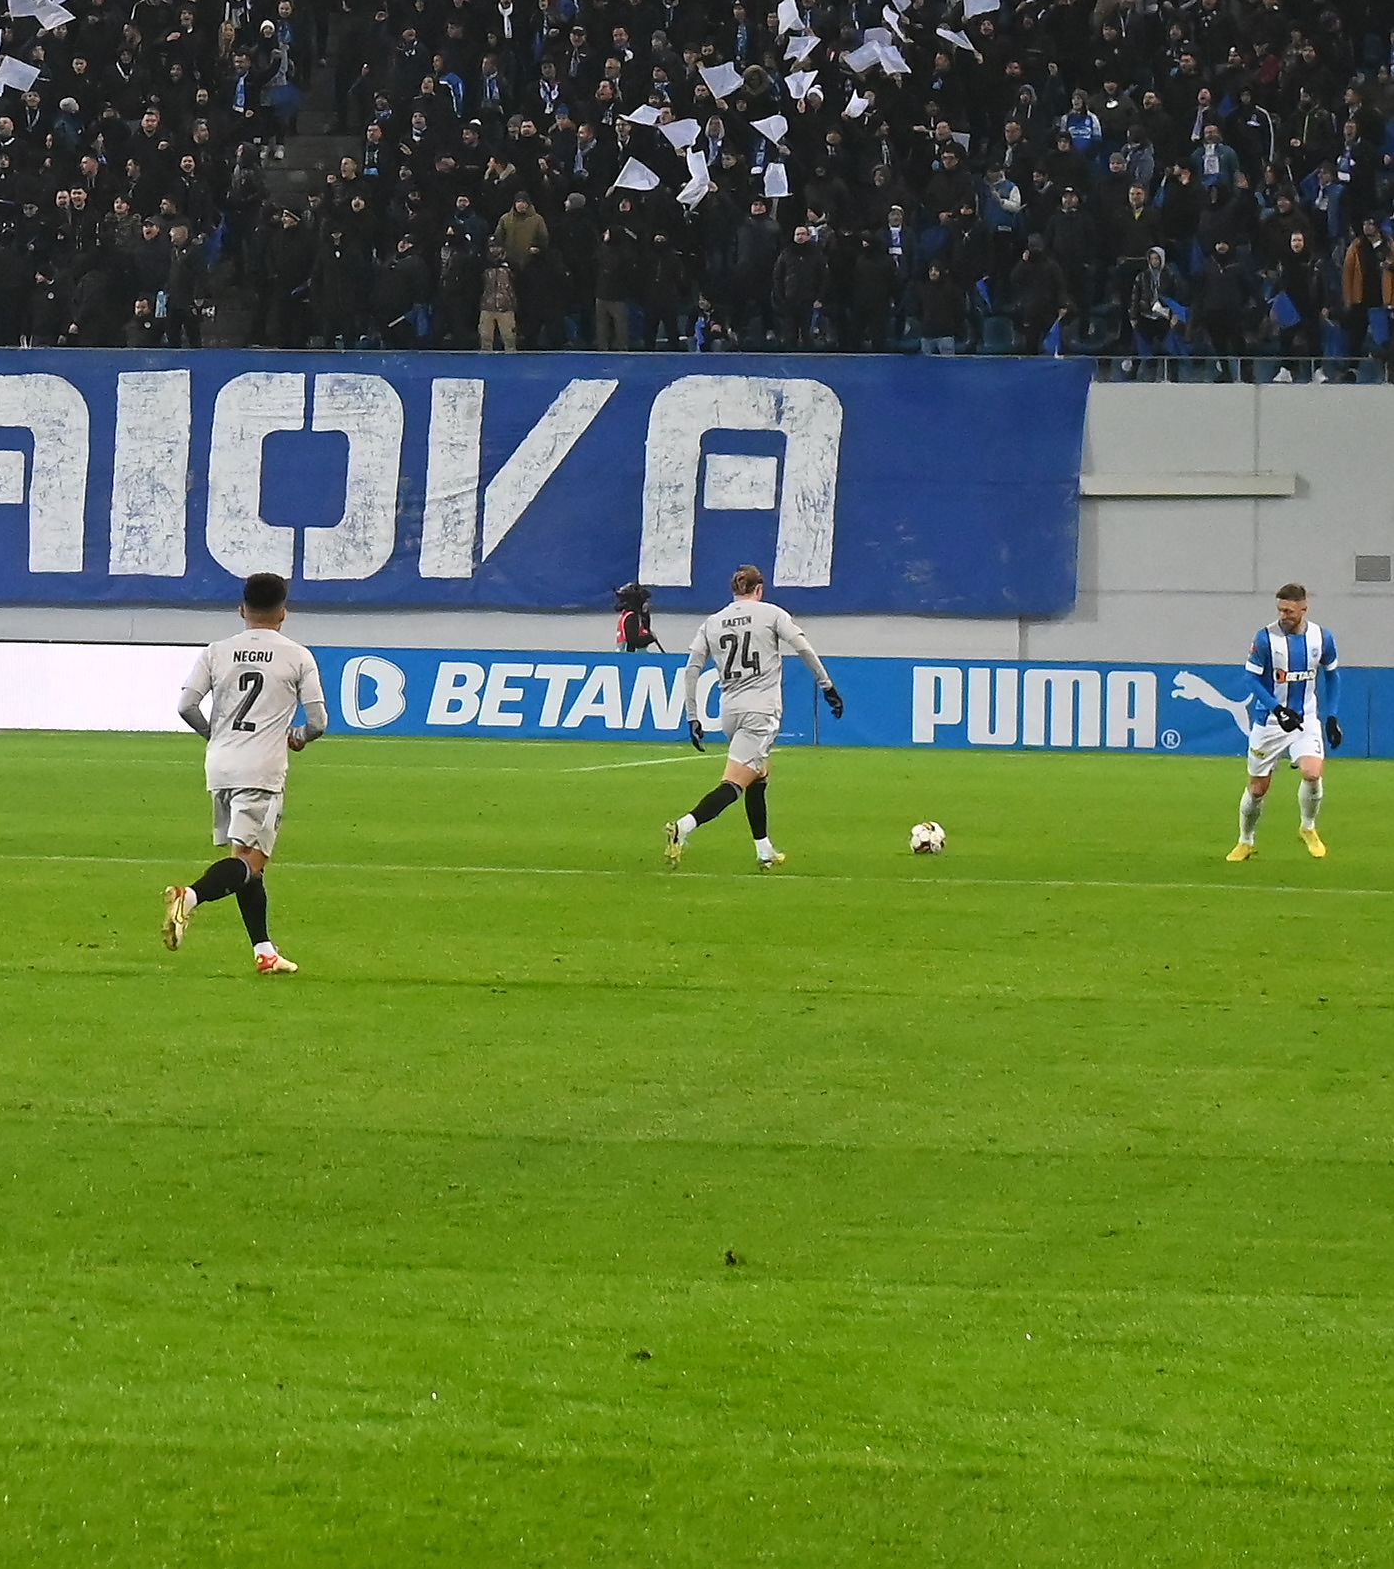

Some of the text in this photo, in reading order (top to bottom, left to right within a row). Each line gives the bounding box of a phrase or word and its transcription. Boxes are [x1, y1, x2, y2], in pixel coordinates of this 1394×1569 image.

[233, 650, 273, 663] NEGRU
[719, 631, 761, 680] 24
[232, 671, 265, 732] 2
[912, 666, 1157, 748] PUMA
